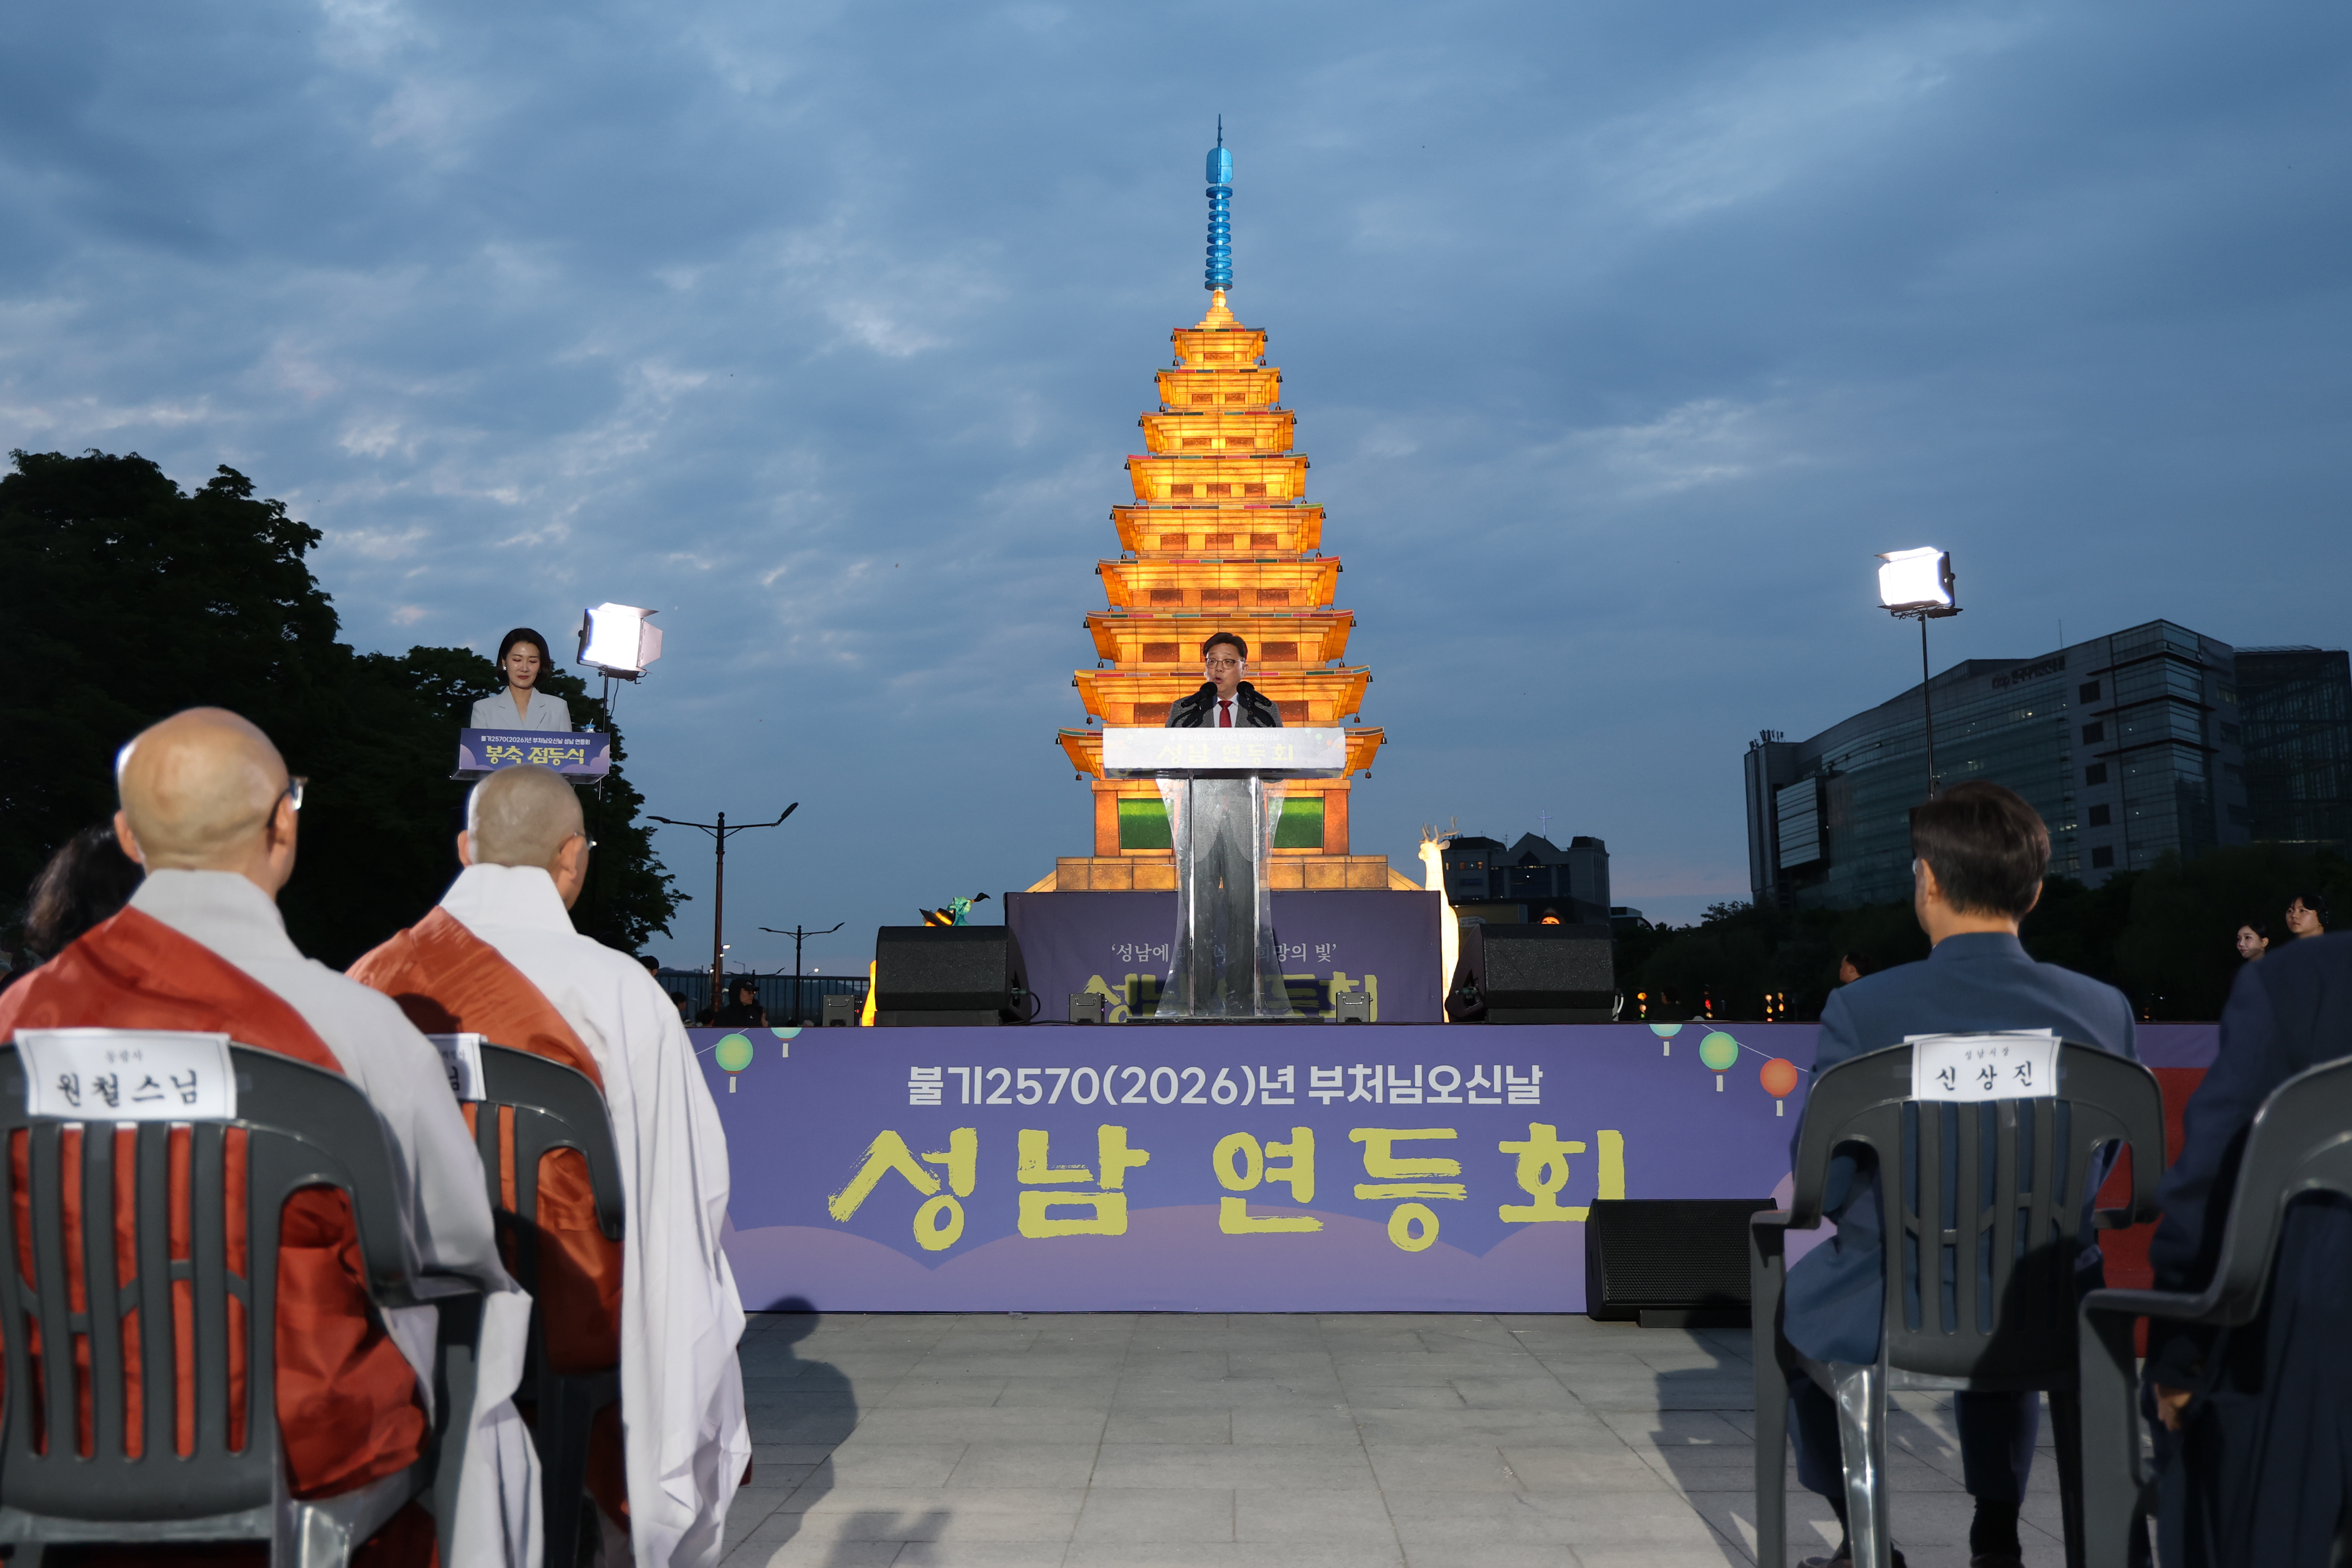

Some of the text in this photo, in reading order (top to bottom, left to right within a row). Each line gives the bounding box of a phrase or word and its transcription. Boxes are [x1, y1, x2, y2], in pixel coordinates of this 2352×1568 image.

[481, 735, 532, 743] 불기2570(2026)년
[1238, 733, 1280, 741] 부처님오신날
[486, 745, 584, 765] 봉축 점등식
[1156, 743, 1293, 766] 성남 연등회
[908, 1063, 1543, 1106] 불기2570(2026)년 부처님오신날
[828, 1122, 1626, 1252] 성남 연등회
